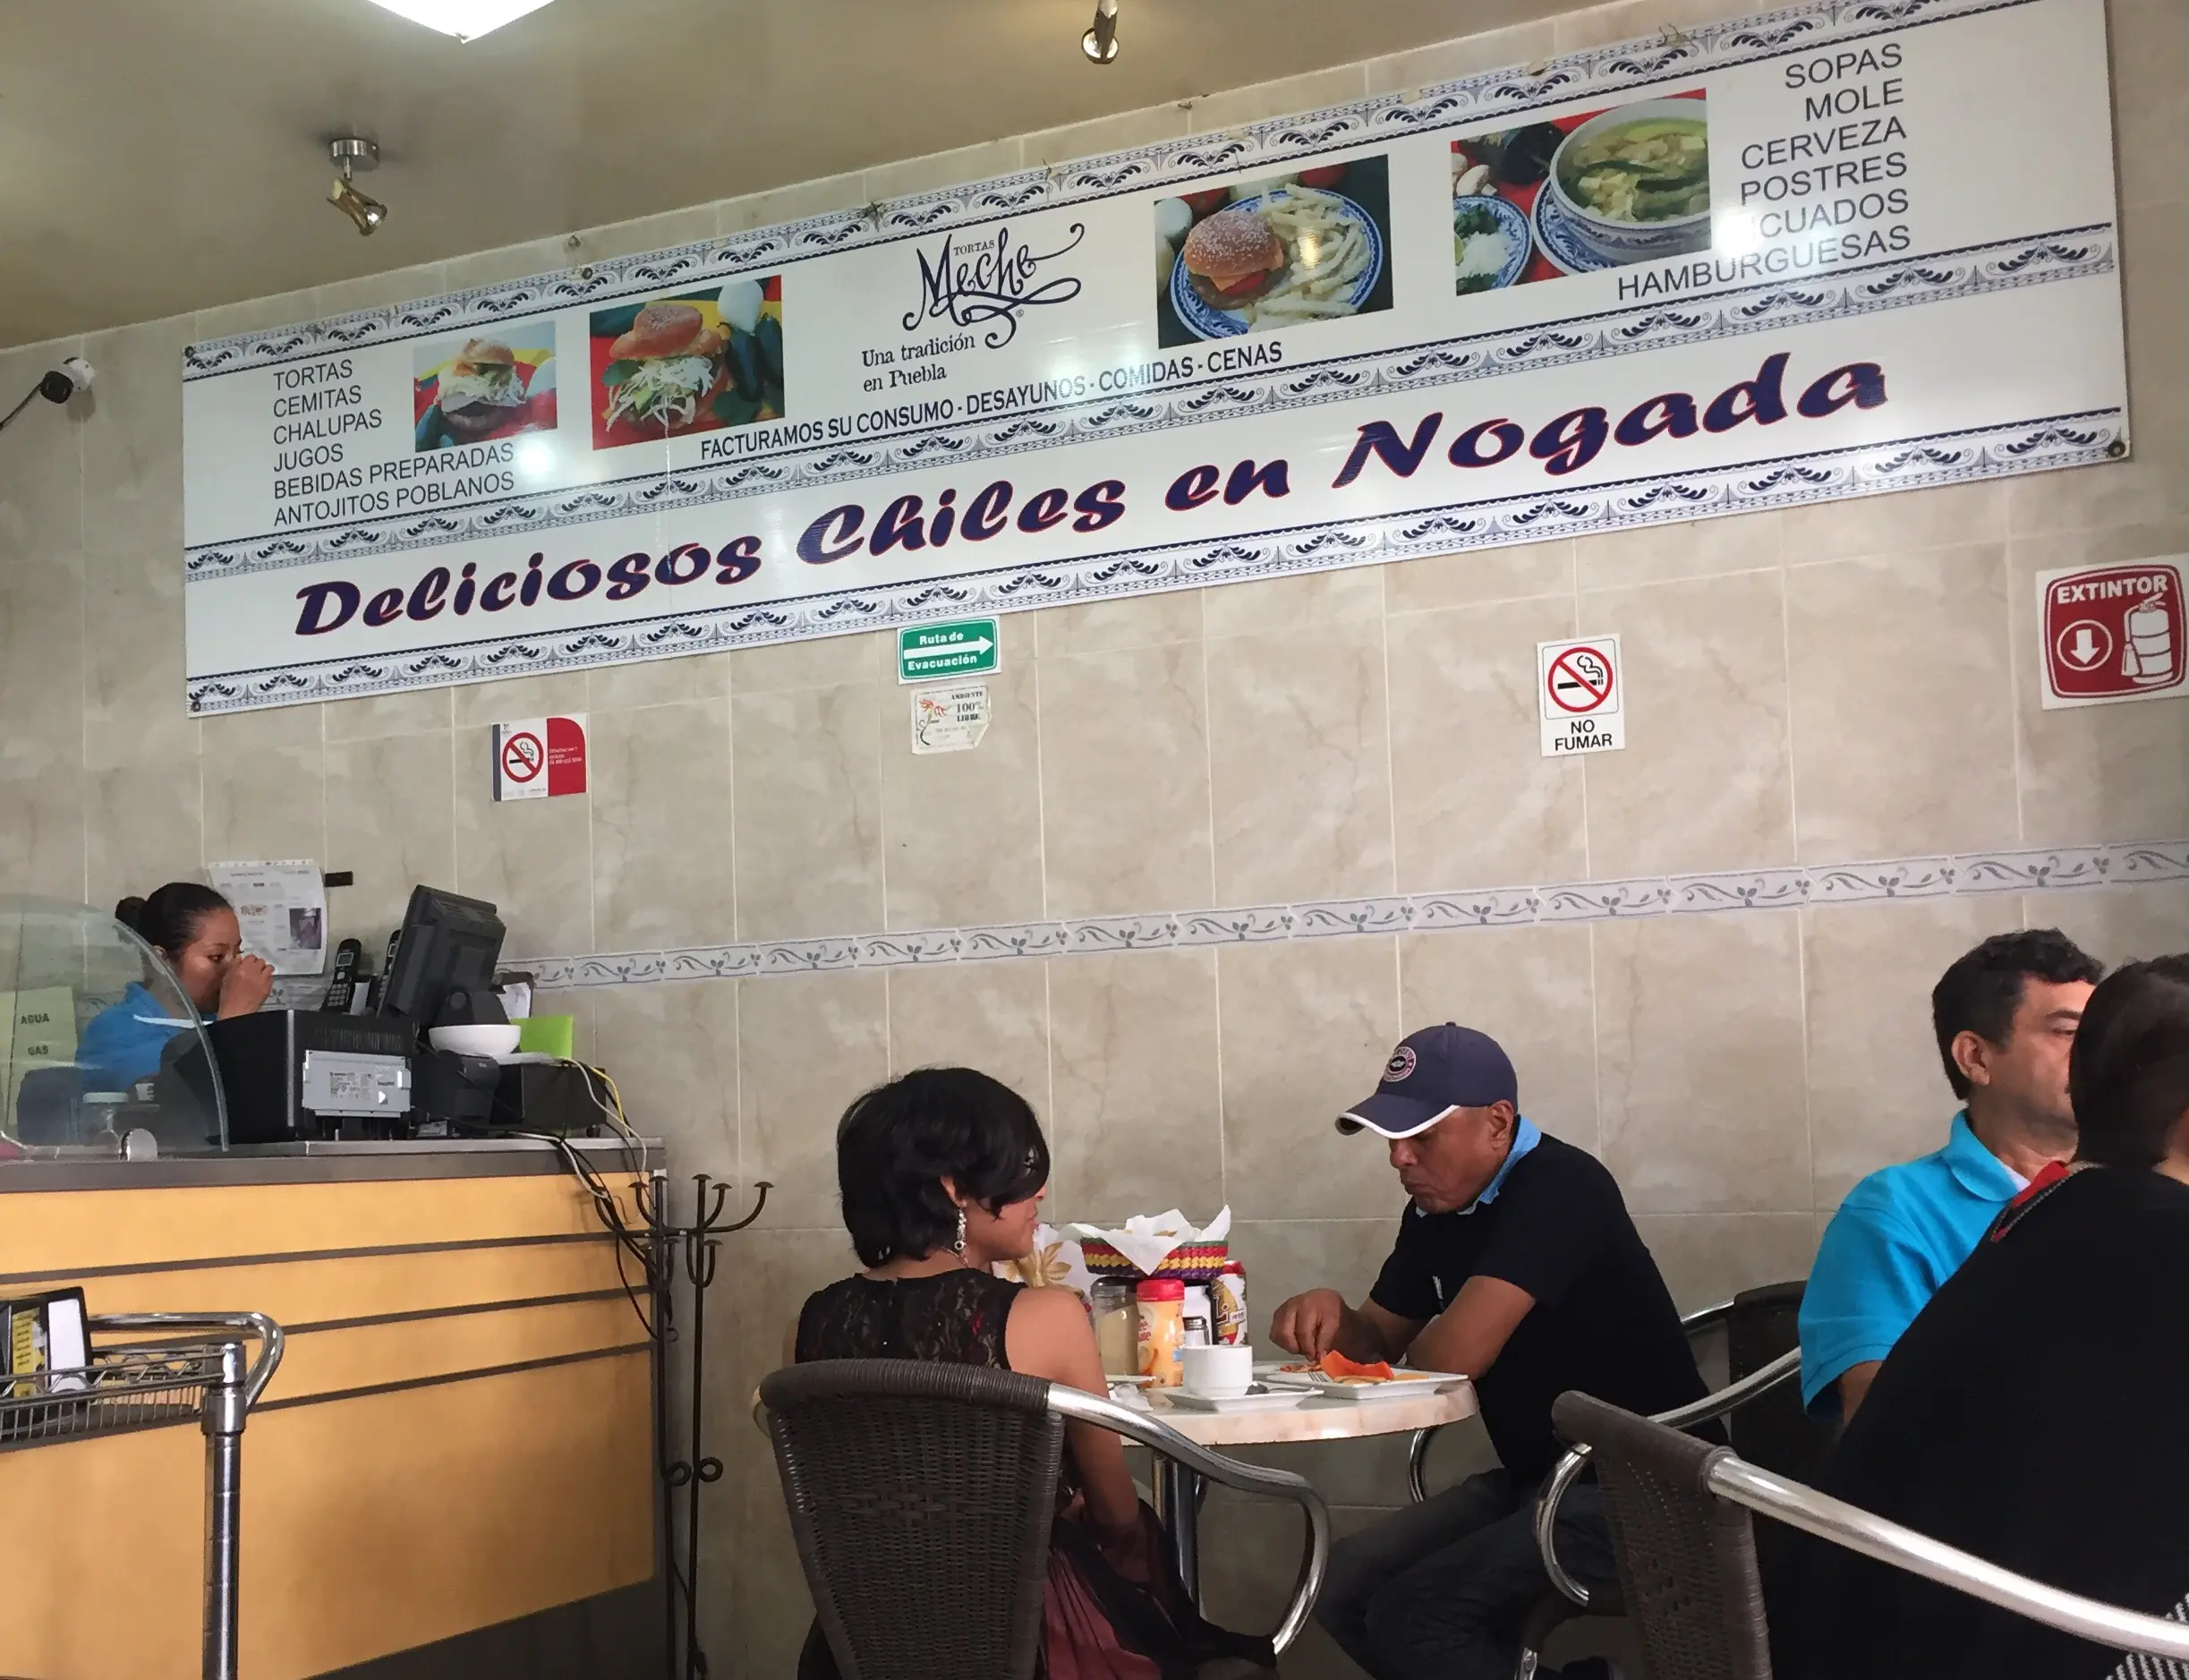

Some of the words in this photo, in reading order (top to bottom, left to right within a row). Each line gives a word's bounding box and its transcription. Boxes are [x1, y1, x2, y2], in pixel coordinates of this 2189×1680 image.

[1784, 43, 1903, 90] SOPAS
[1805, 78, 1904, 122] MOLE
[1742, 115, 1907, 169] CERVEZA
[1741, 151, 1907, 206] POSTRES
[1752, 188, 1909, 240] CUADOS
[953, 240, 995, 256] TORTAS
[1618, 225, 1911, 300] HAMBURGUESAS
[902, 223, 1086, 349] Meche
[862, 348, 894, 368] Una
[900, 333, 976, 362] tradición
[273, 359, 353, 391] TORTAS
[864, 377, 884, 393] en
[889, 363, 947, 389] Puebla
[273, 385, 362, 418] CEMITAS
[701, 421, 823, 460] FACTURAMOS
[829, 416, 852, 439] SU
[857, 397, 954, 433] CONSUMO
[967, 374, 1086, 416] DESAYUNOS
[1099, 356, 1194, 391] COMIDAS
[1208, 341, 1282, 372] CENAS
[273, 408, 382, 445] CHALUPAS
[273, 443, 344, 472] JUGOS
[274, 468, 362, 499] BEBIDAS
[370, 442, 514, 482] PREPARADAS
[274, 490, 389, 526] ANTOJITOS
[396, 471, 515, 507] POBLANOS
[295, 535, 762, 635] Deliciosos
[796, 479, 1127, 566] Chiles
[1165, 459, 1290, 511] en
[1332, 352, 1888, 489] Nogada
[2057, 575, 2168, 604] EXTINTOR
[919, 633, 947, 645] Ruta
[949, 632, 964, 641] de
[907, 654, 977, 670] Evacuación
[1554, 733, 1613, 751] FUMAR
[1571, 719, 1595, 734] NO
[21, 1013, 50, 1024] AGUA
